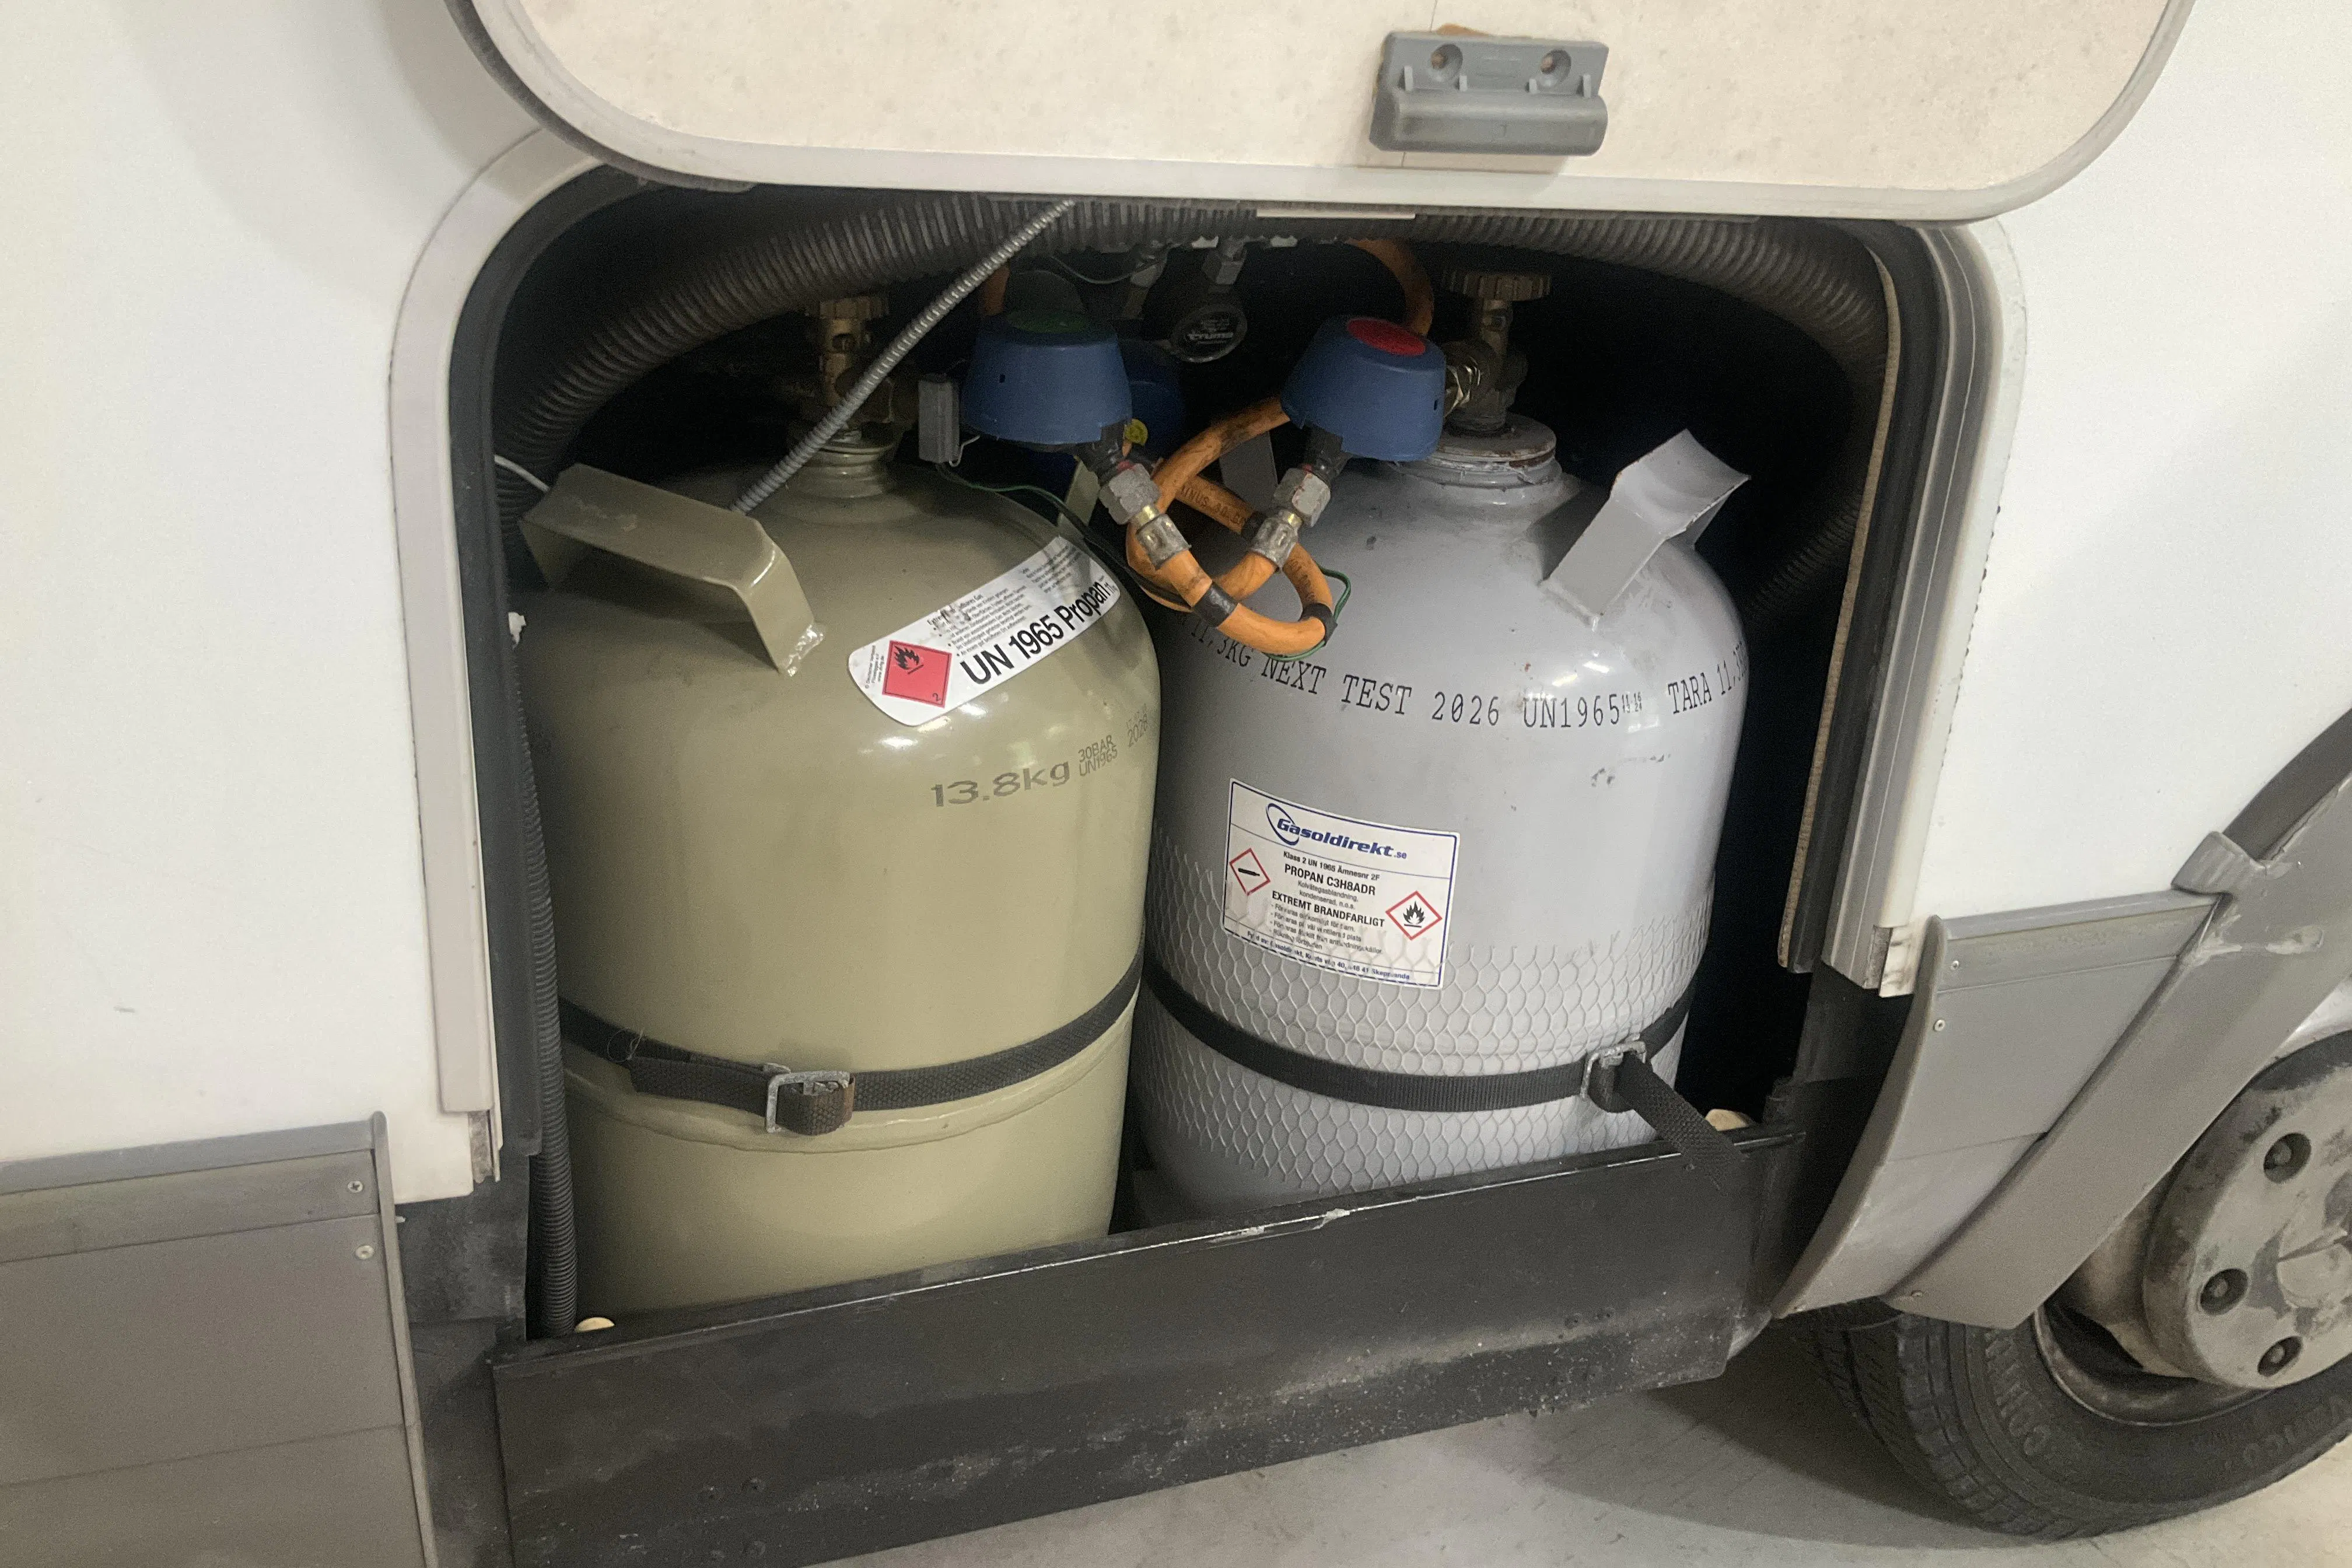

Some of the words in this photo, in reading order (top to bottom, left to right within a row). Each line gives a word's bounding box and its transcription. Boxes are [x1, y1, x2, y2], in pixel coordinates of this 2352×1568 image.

[960, 644, 1015, 685] UN
[1009, 614, 1065, 660] 1965
[1055, 581, 1111, 631] Propan
[1261, 654, 1326, 695] NEXT
[1341, 674, 1412, 715] TEST
[1431, 691, 1500, 726] 2026
[1521, 693, 1620, 729] UN1965
[1668, 672, 1712, 715] TARA
[1078, 734, 1114, 763] 30BAR
[1079, 745, 1118, 776] UN1965
[931, 761, 1070, 807] 13.8kg
[1283, 850, 1300, 862] Klass
[1308, 859, 1317, 867] UN
[1320, 862, 1335, 872] 1965
[1284, 863, 1324, 884] PROPAN
[1327, 876, 1376, 895] C3H8ADR
[1272, 890, 1312, 911] EXTREMT
[1314, 905, 1385, 927] BRANDFARLIGT
